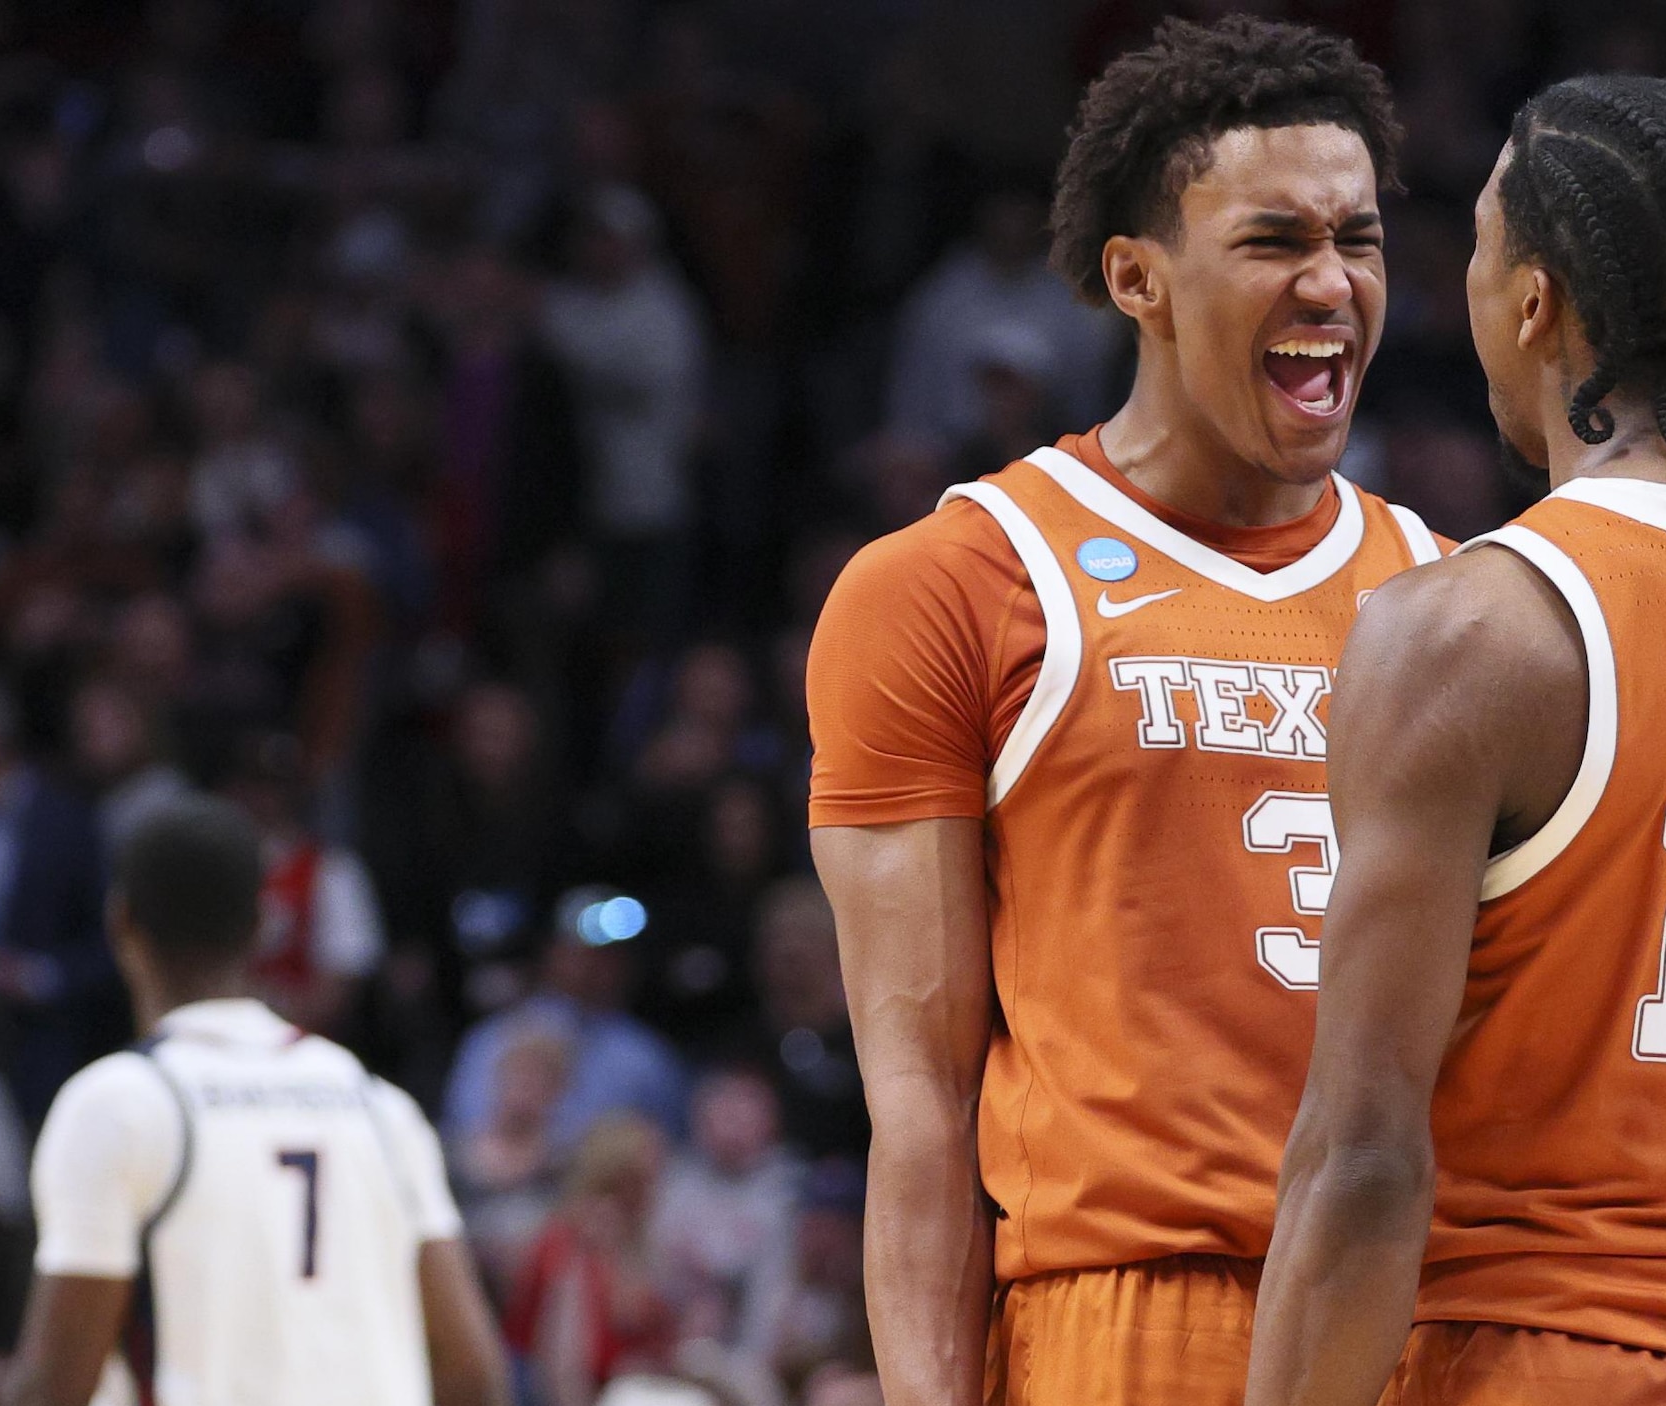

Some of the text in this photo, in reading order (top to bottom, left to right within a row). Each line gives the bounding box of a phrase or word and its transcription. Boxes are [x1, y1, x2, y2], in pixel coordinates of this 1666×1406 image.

[1087, 556, 1133, 570] NCAA
[1109, 657, 1336, 761] TEX
[1243, 791, 1339, 990] 3
